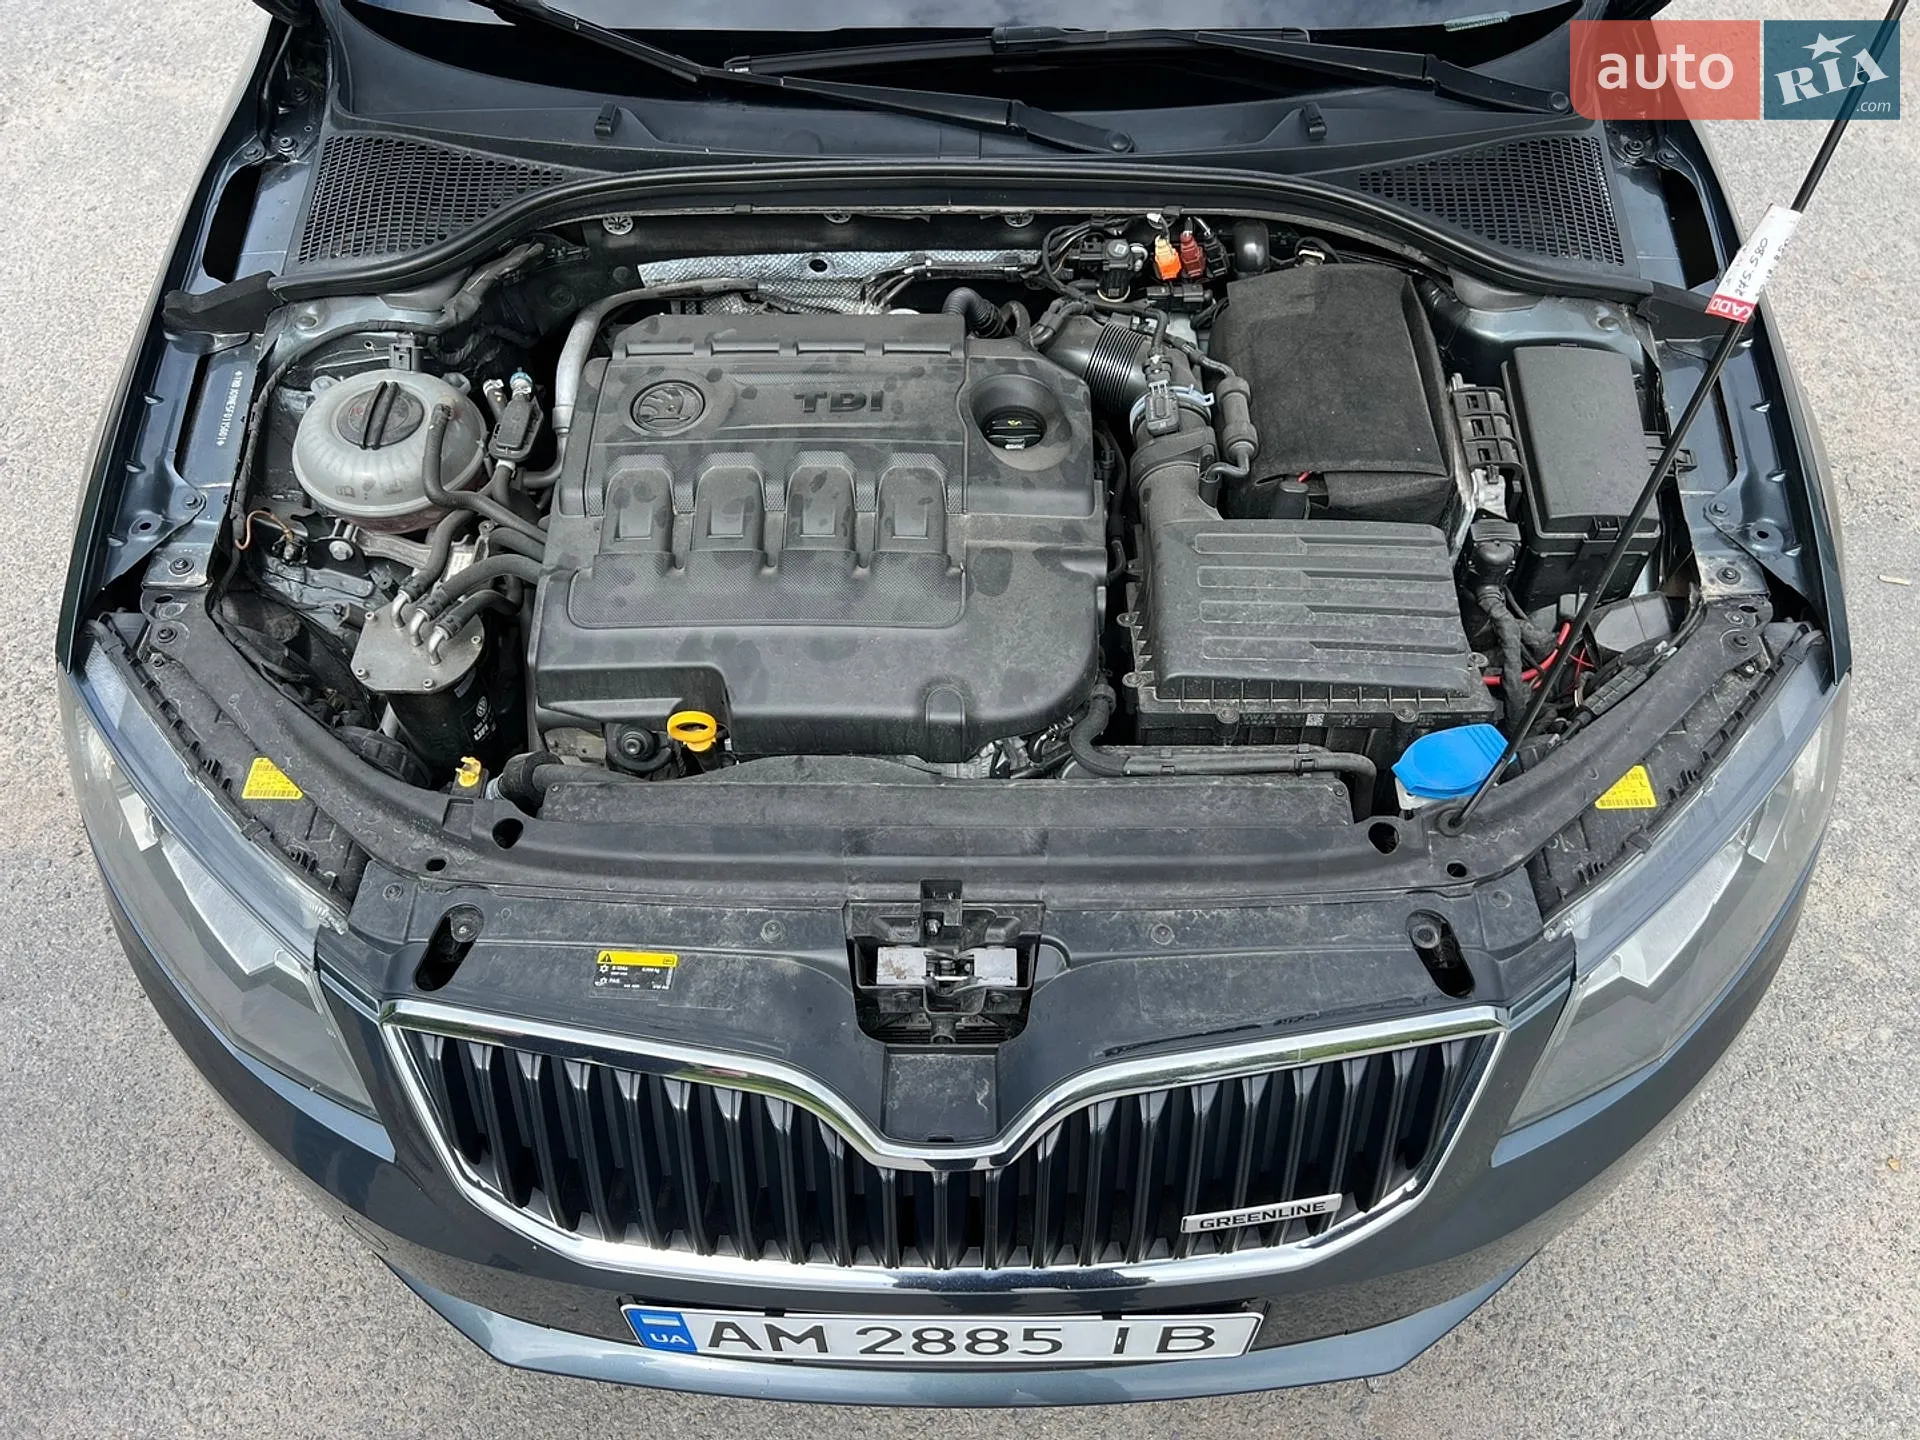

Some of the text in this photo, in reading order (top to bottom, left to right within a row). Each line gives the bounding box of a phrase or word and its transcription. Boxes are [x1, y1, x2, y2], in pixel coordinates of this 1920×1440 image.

[793, 389, 884, 413] TDI
[1200, 1201, 1326, 1229] GREENLINE
[650, 1332, 689, 1345] UA
[708, 1320, 829, 1354] AM
[856, 1326, 1064, 1355] 2885
